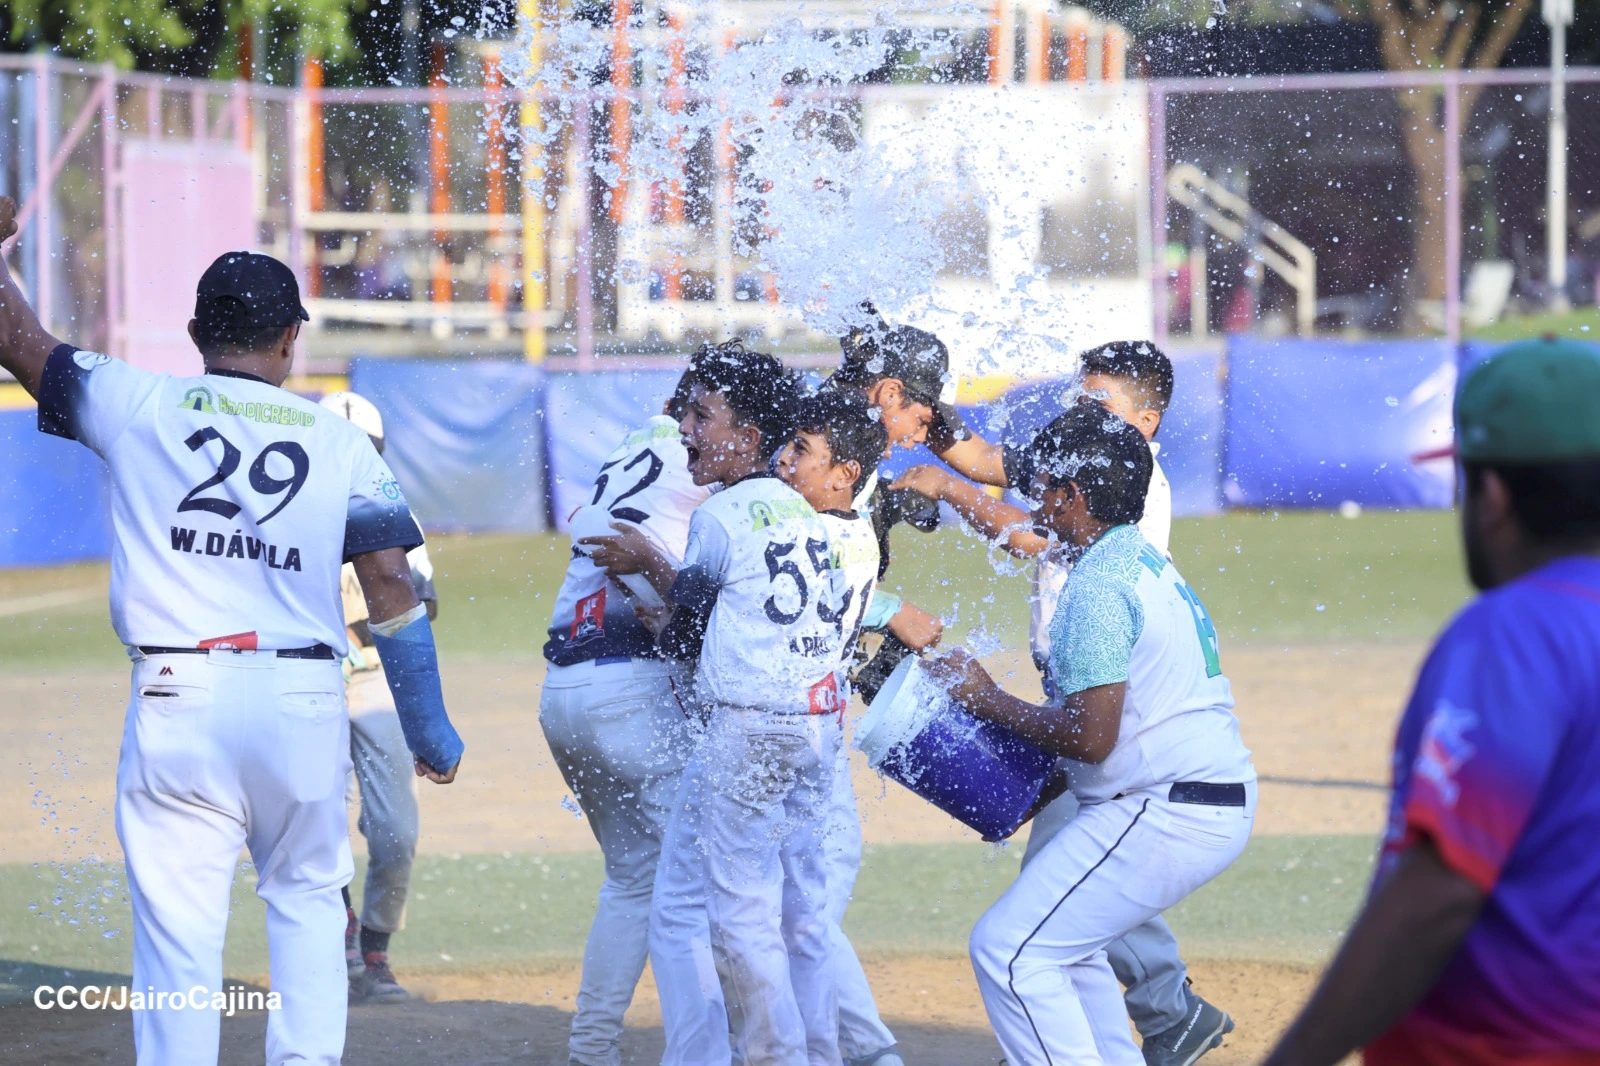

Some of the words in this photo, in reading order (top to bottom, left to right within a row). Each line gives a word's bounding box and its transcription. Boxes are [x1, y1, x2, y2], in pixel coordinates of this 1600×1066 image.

[176, 425, 310, 526] 29
[170, 526, 302, 572] W.DÁVILA
[1172, 1030, 1189, 1052] UNDER
[1188, 1003, 1203, 1031] ARMOUR
